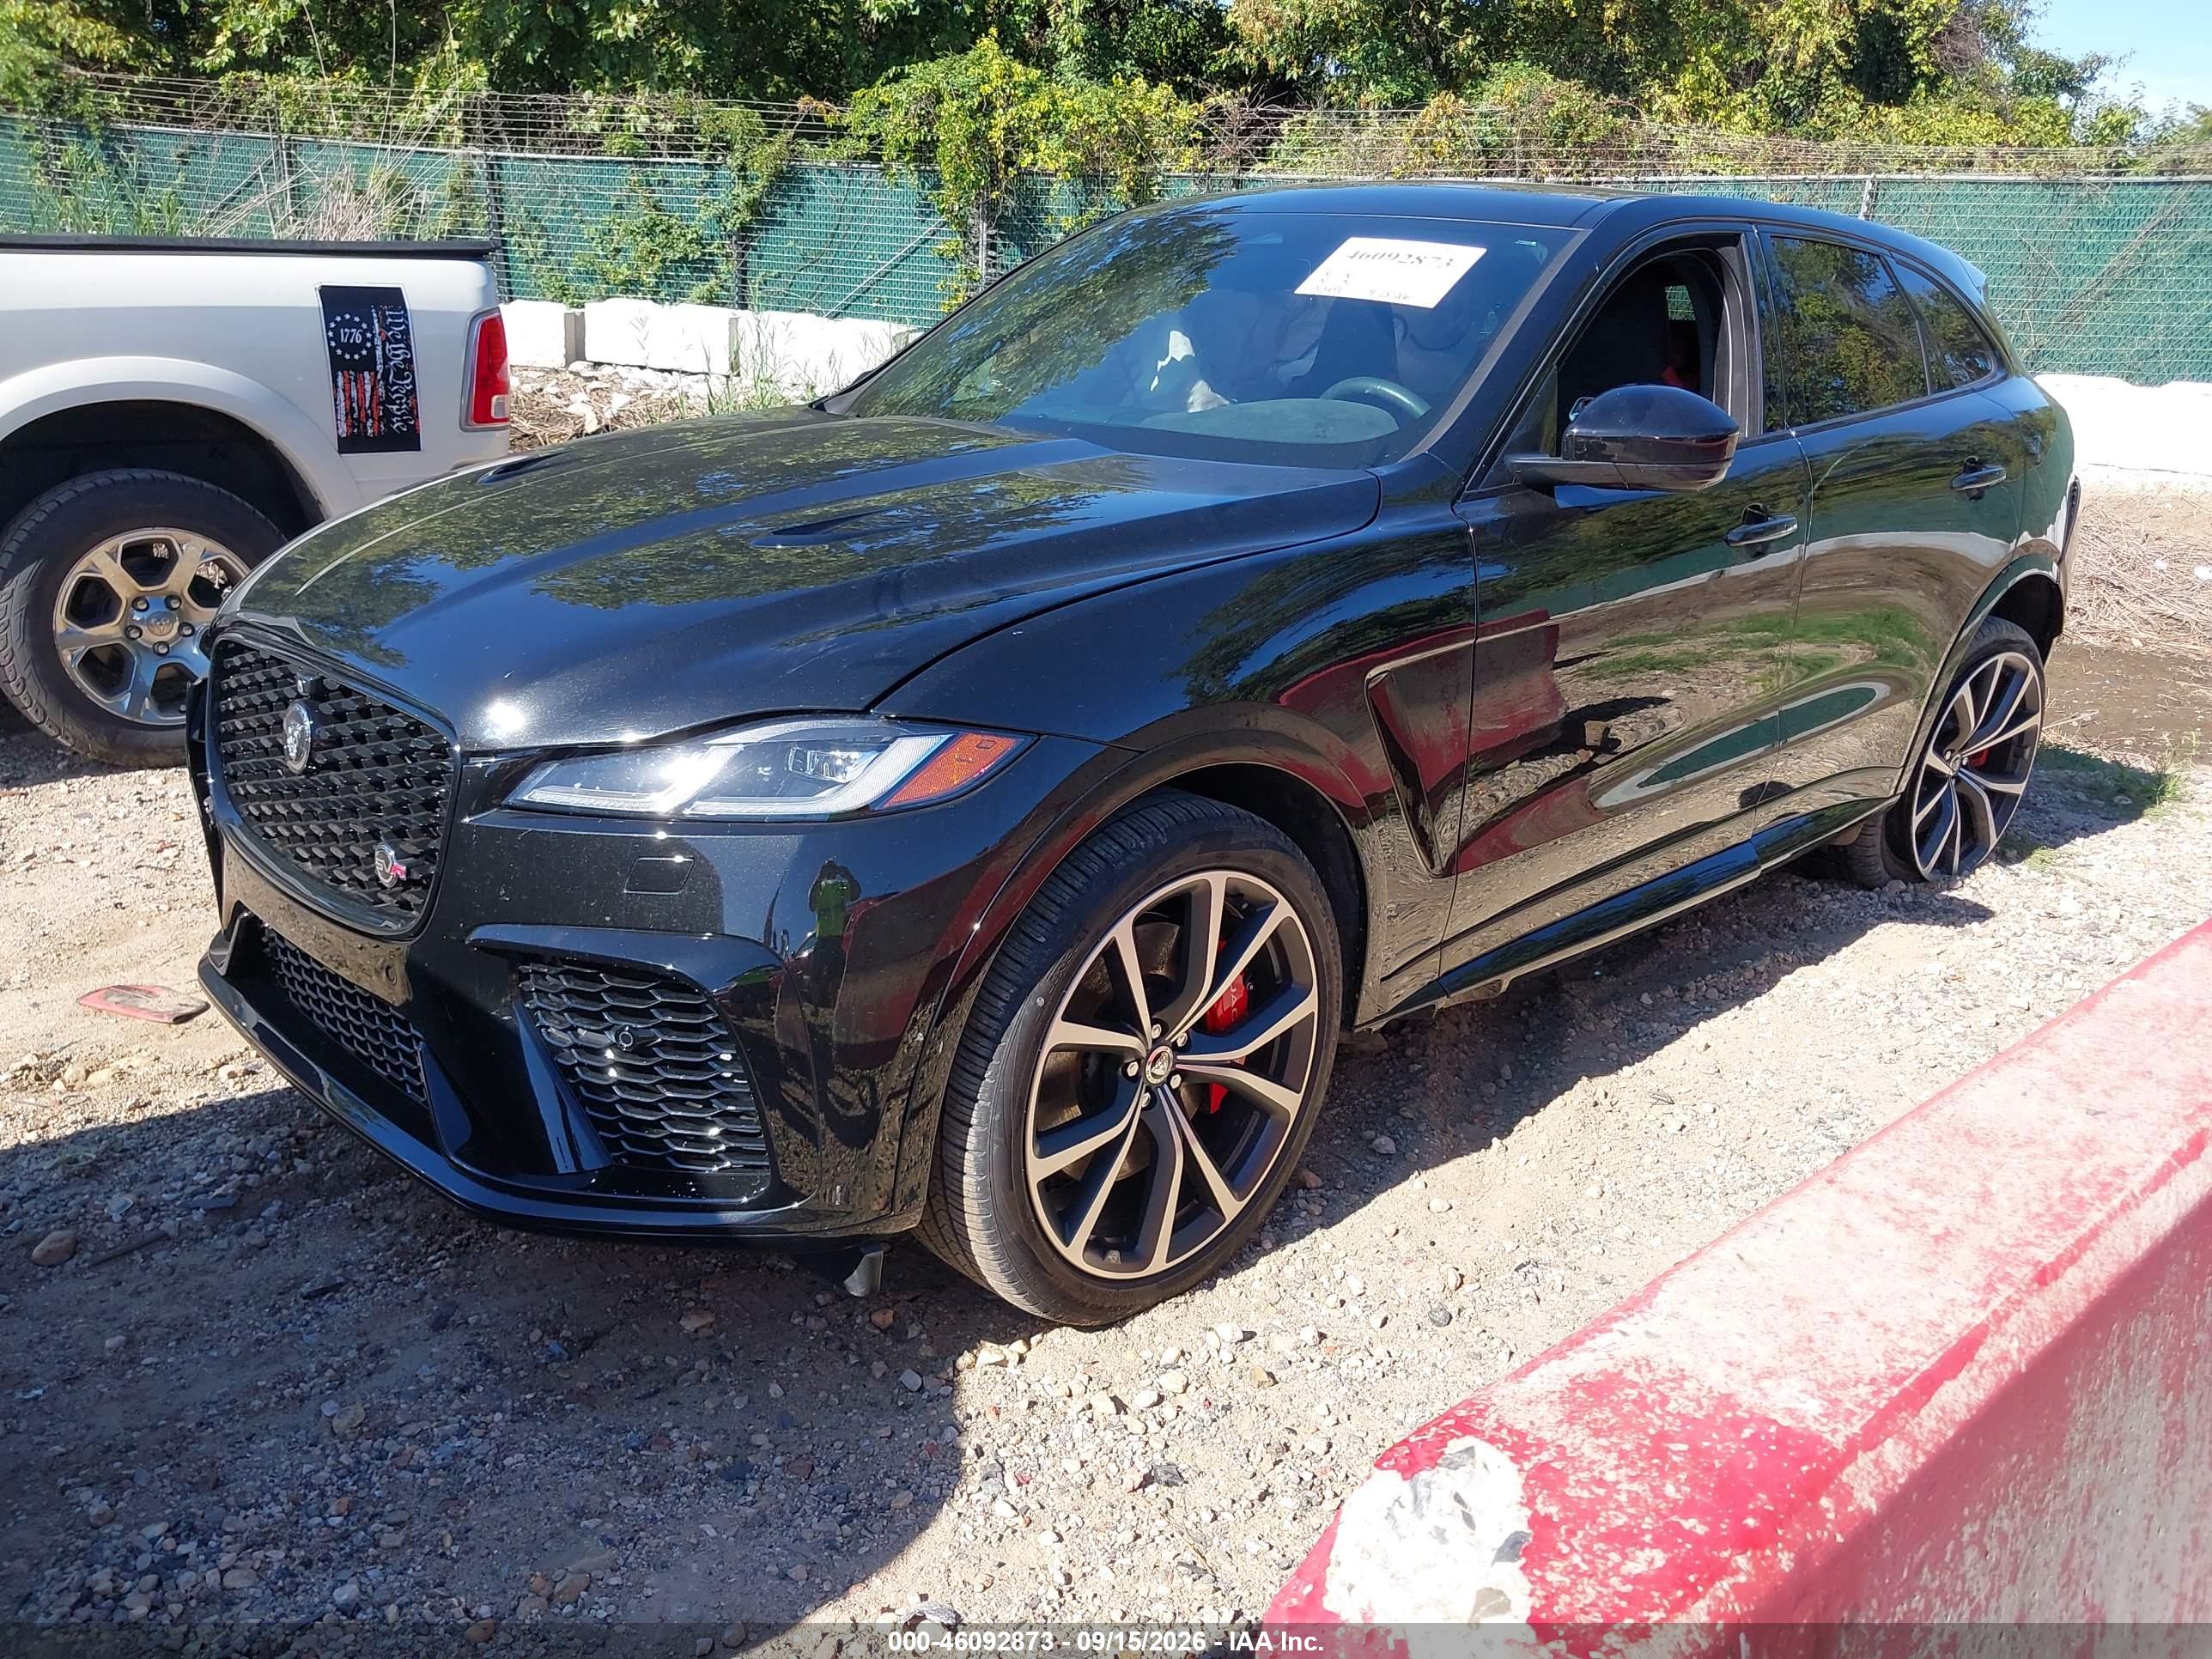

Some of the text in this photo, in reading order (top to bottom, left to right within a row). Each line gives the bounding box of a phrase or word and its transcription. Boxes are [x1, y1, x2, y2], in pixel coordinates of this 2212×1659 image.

[1346, 249, 1455, 269] 46092873
[340, 327, 363, 343] 1776
[386, 364, 415, 434] People
